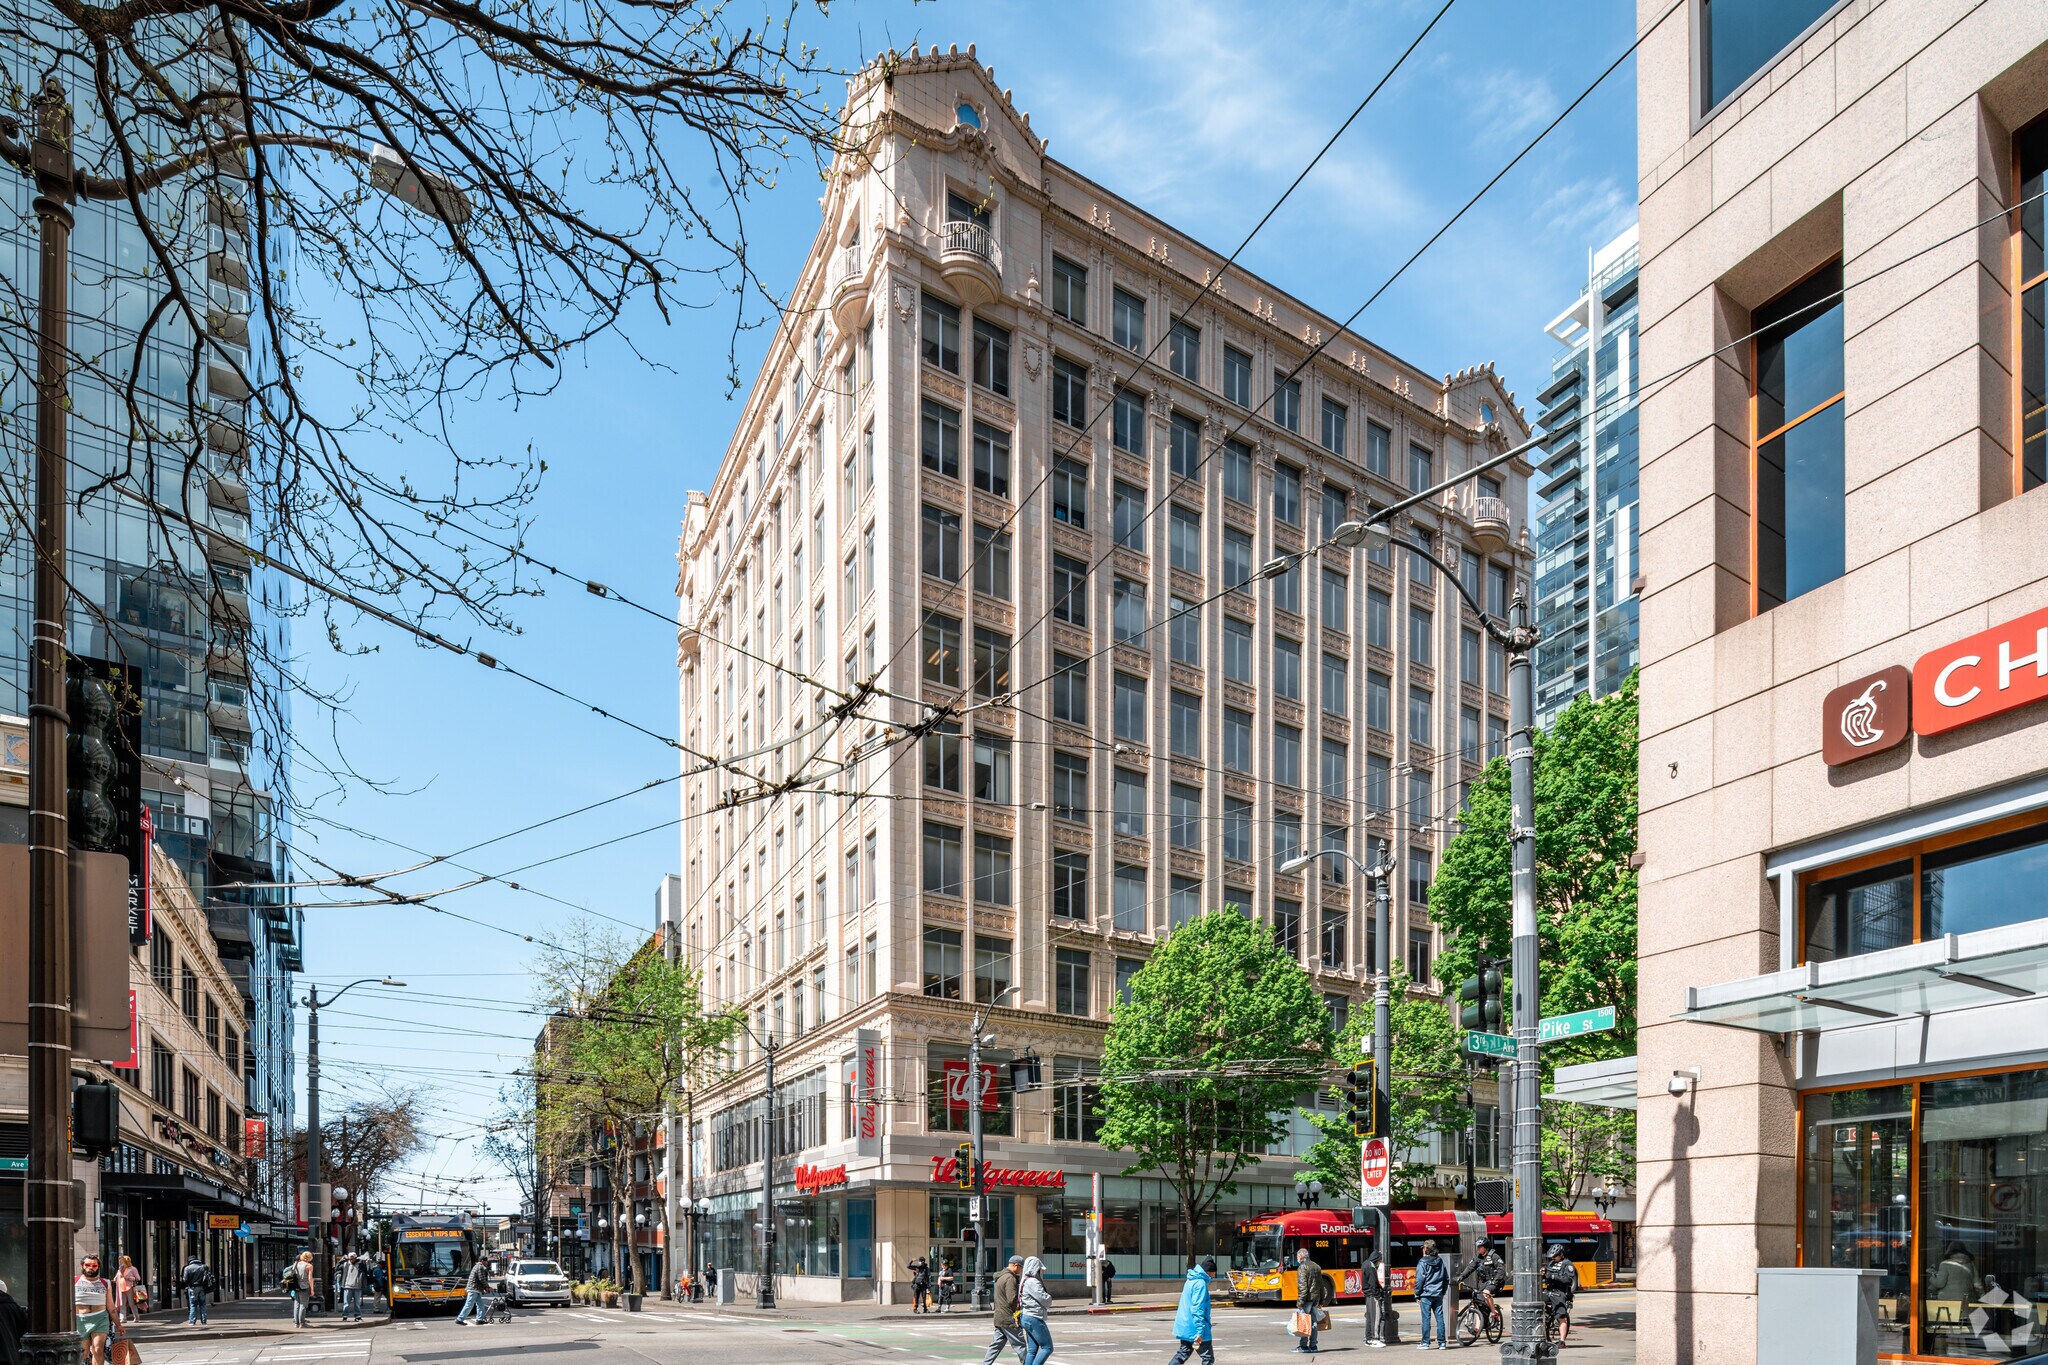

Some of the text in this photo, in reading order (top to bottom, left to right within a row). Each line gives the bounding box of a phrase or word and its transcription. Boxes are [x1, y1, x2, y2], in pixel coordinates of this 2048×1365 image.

[1598, 1008, 1613, 1018] 1500
[1542, 1019, 1594, 1038] Pike St
[1472, 1034, 1515, 1053] 3rd Ave
[861, 1047, 880, 1140] Walreens
[1366, 1147, 1385, 1158] DO NOT
[1366, 1169, 1383, 1179] ENTER
[794, 1163, 849, 1197] Walgreens
[405, 1230, 463, 1239] ESSENTIAL TRIPS ONLY
[1315, 1240, 1330, 1248] 6202
